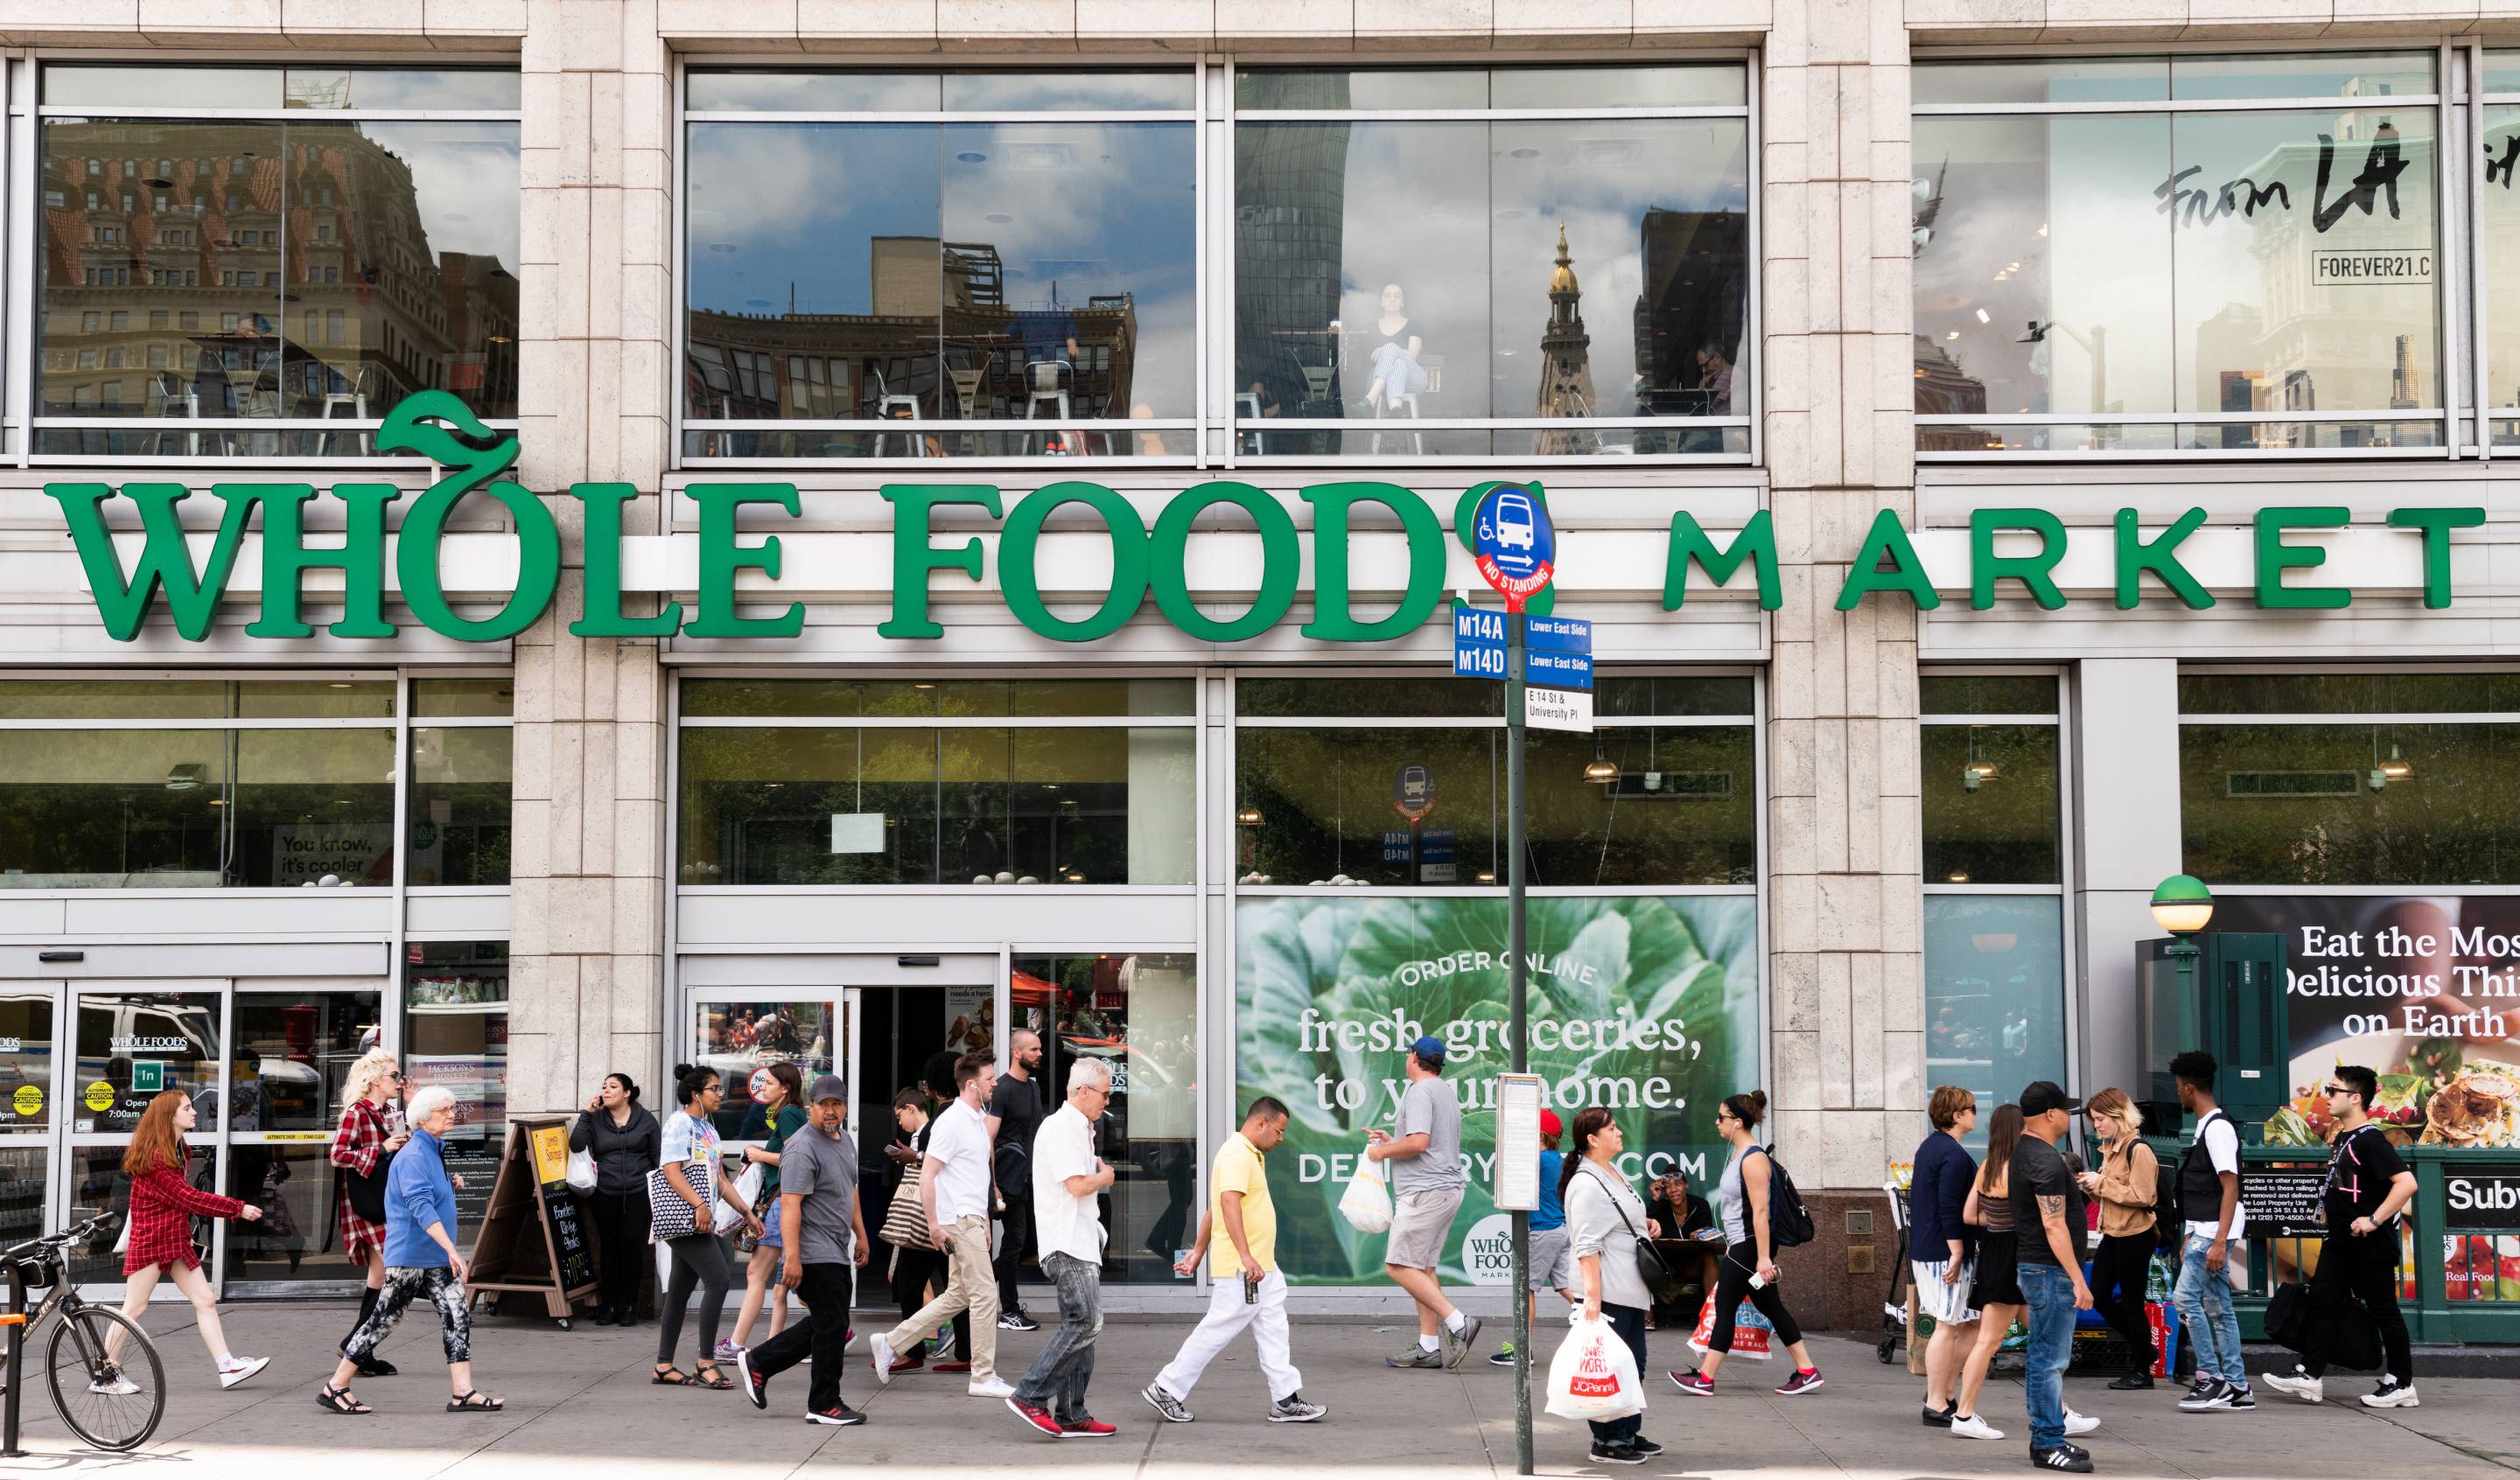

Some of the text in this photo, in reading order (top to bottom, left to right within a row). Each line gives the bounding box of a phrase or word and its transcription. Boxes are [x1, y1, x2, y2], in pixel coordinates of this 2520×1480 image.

[2313, 122, 2410, 233] LA
[2319, 256, 2430, 278] FOREVER21.C
[43, 390, 807, 643] WHOLE
[1662, 506, 2486, 611] MARKET
[1483, 560, 1549, 592] NO STANDING
[1459, 613, 1503, 640] M14A
[1530, 620, 1587, 637] Lower East Side
[1459, 648, 1504, 674] M14D
[1530, 655, 1588, 671] Lower East Side
[1530, 691, 1564, 704] E 14 St &
[1530, 705, 1578, 721] University Pl
[283, 836, 372, 854] You know,
[282, 855, 364, 873] it's cooler
[2301, 925, 2520, 957] Eat the Mos
[1401, 951, 1490, 986] ORDER
[2342, 1005, 2507, 1037] on Earth
[110, 1034, 188, 1048] WHOLE FOODS
[1297, 1006, 1701, 1062] fresh groceries,
[142, 1071, 154, 1081] In
[428, 1063, 475, 1074] JACKSON'S
[125, 1100, 147, 1108] Open
[1315, 1072, 1364, 1109] to
[1382, 1079, 1497, 1120] yur
[1471, 1232, 1512, 1253] WHO
[1474, 1255, 1512, 1268] FOO
[2446, 1272, 2468, 1281] Real
